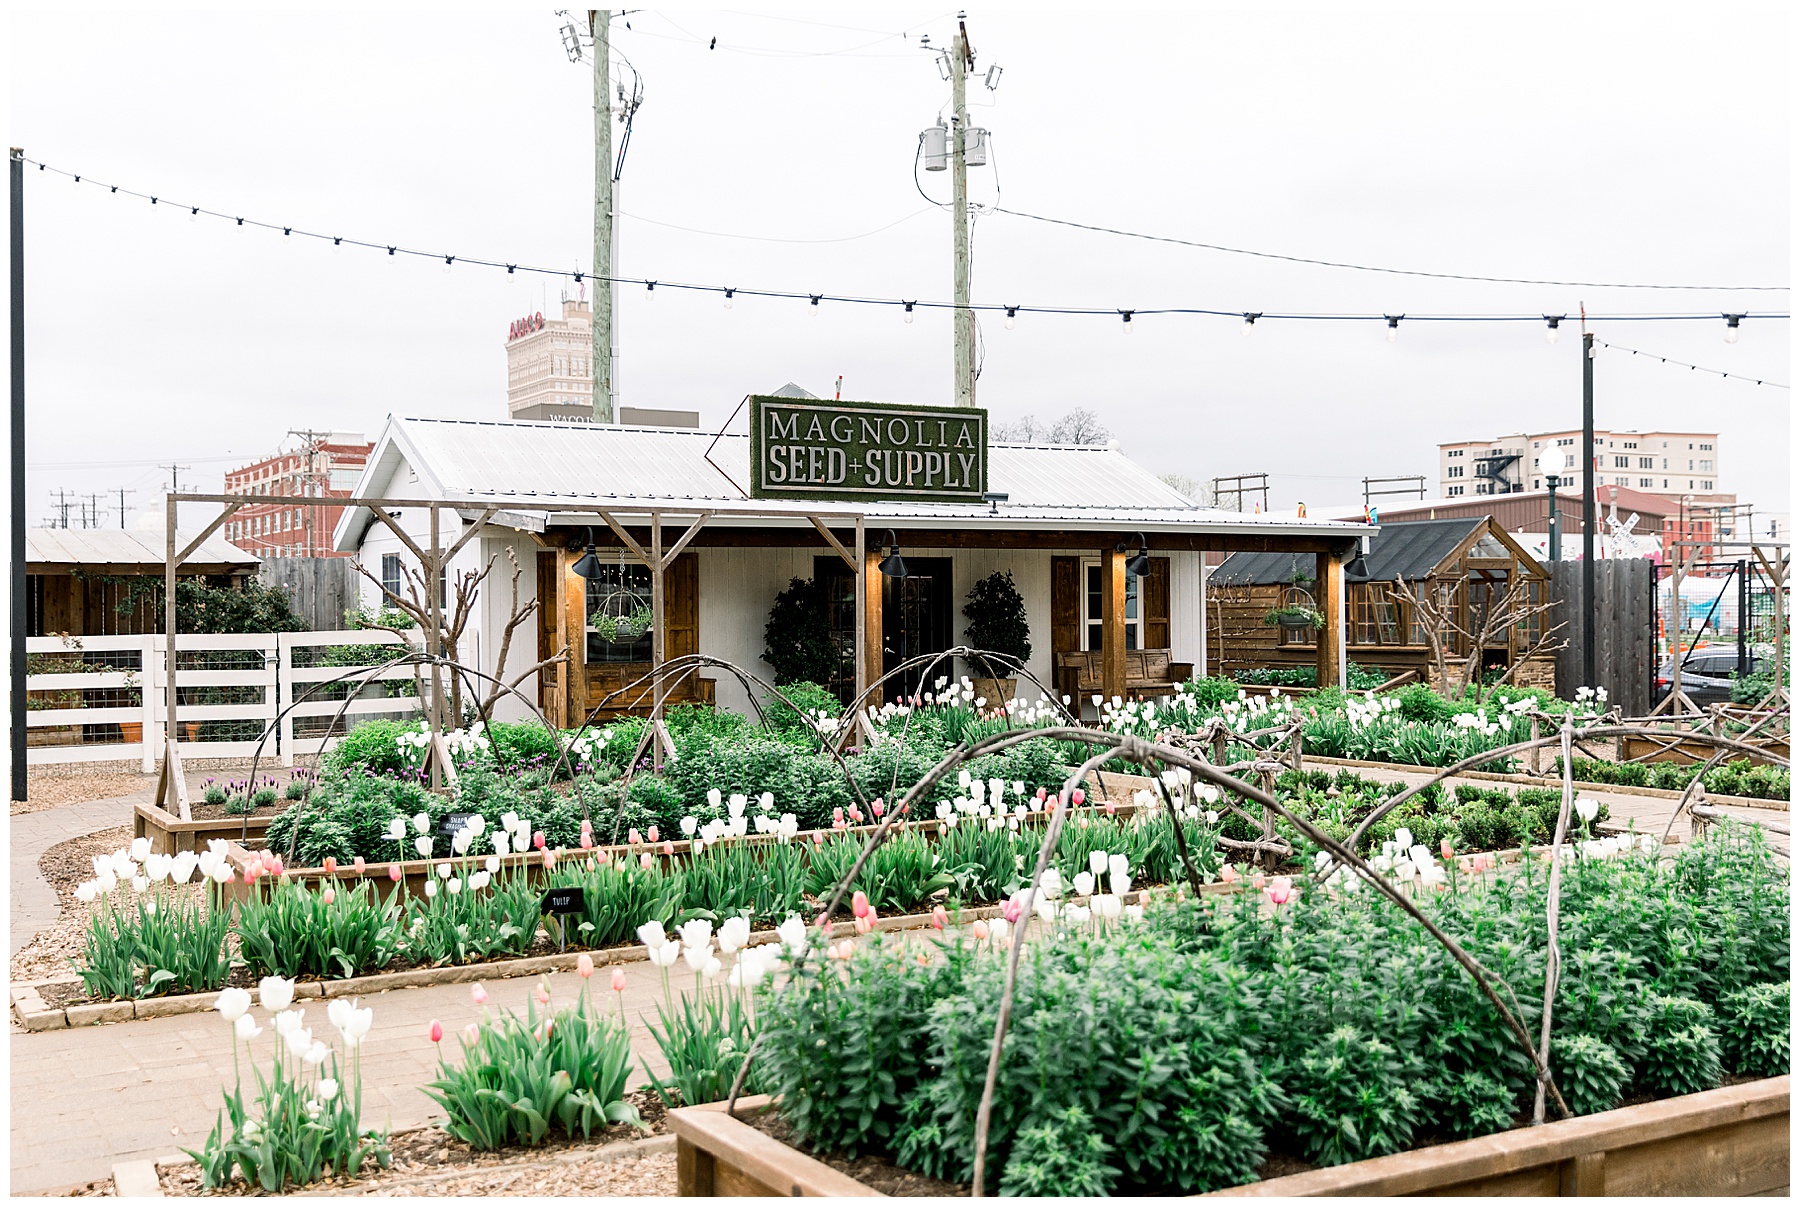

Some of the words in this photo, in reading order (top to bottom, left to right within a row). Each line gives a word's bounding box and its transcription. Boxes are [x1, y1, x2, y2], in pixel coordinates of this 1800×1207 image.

[769, 411, 975, 449] MAGNOLIA
[1608, 516, 1639, 549] RAROAD
[552, 896, 571, 906] TULIP
